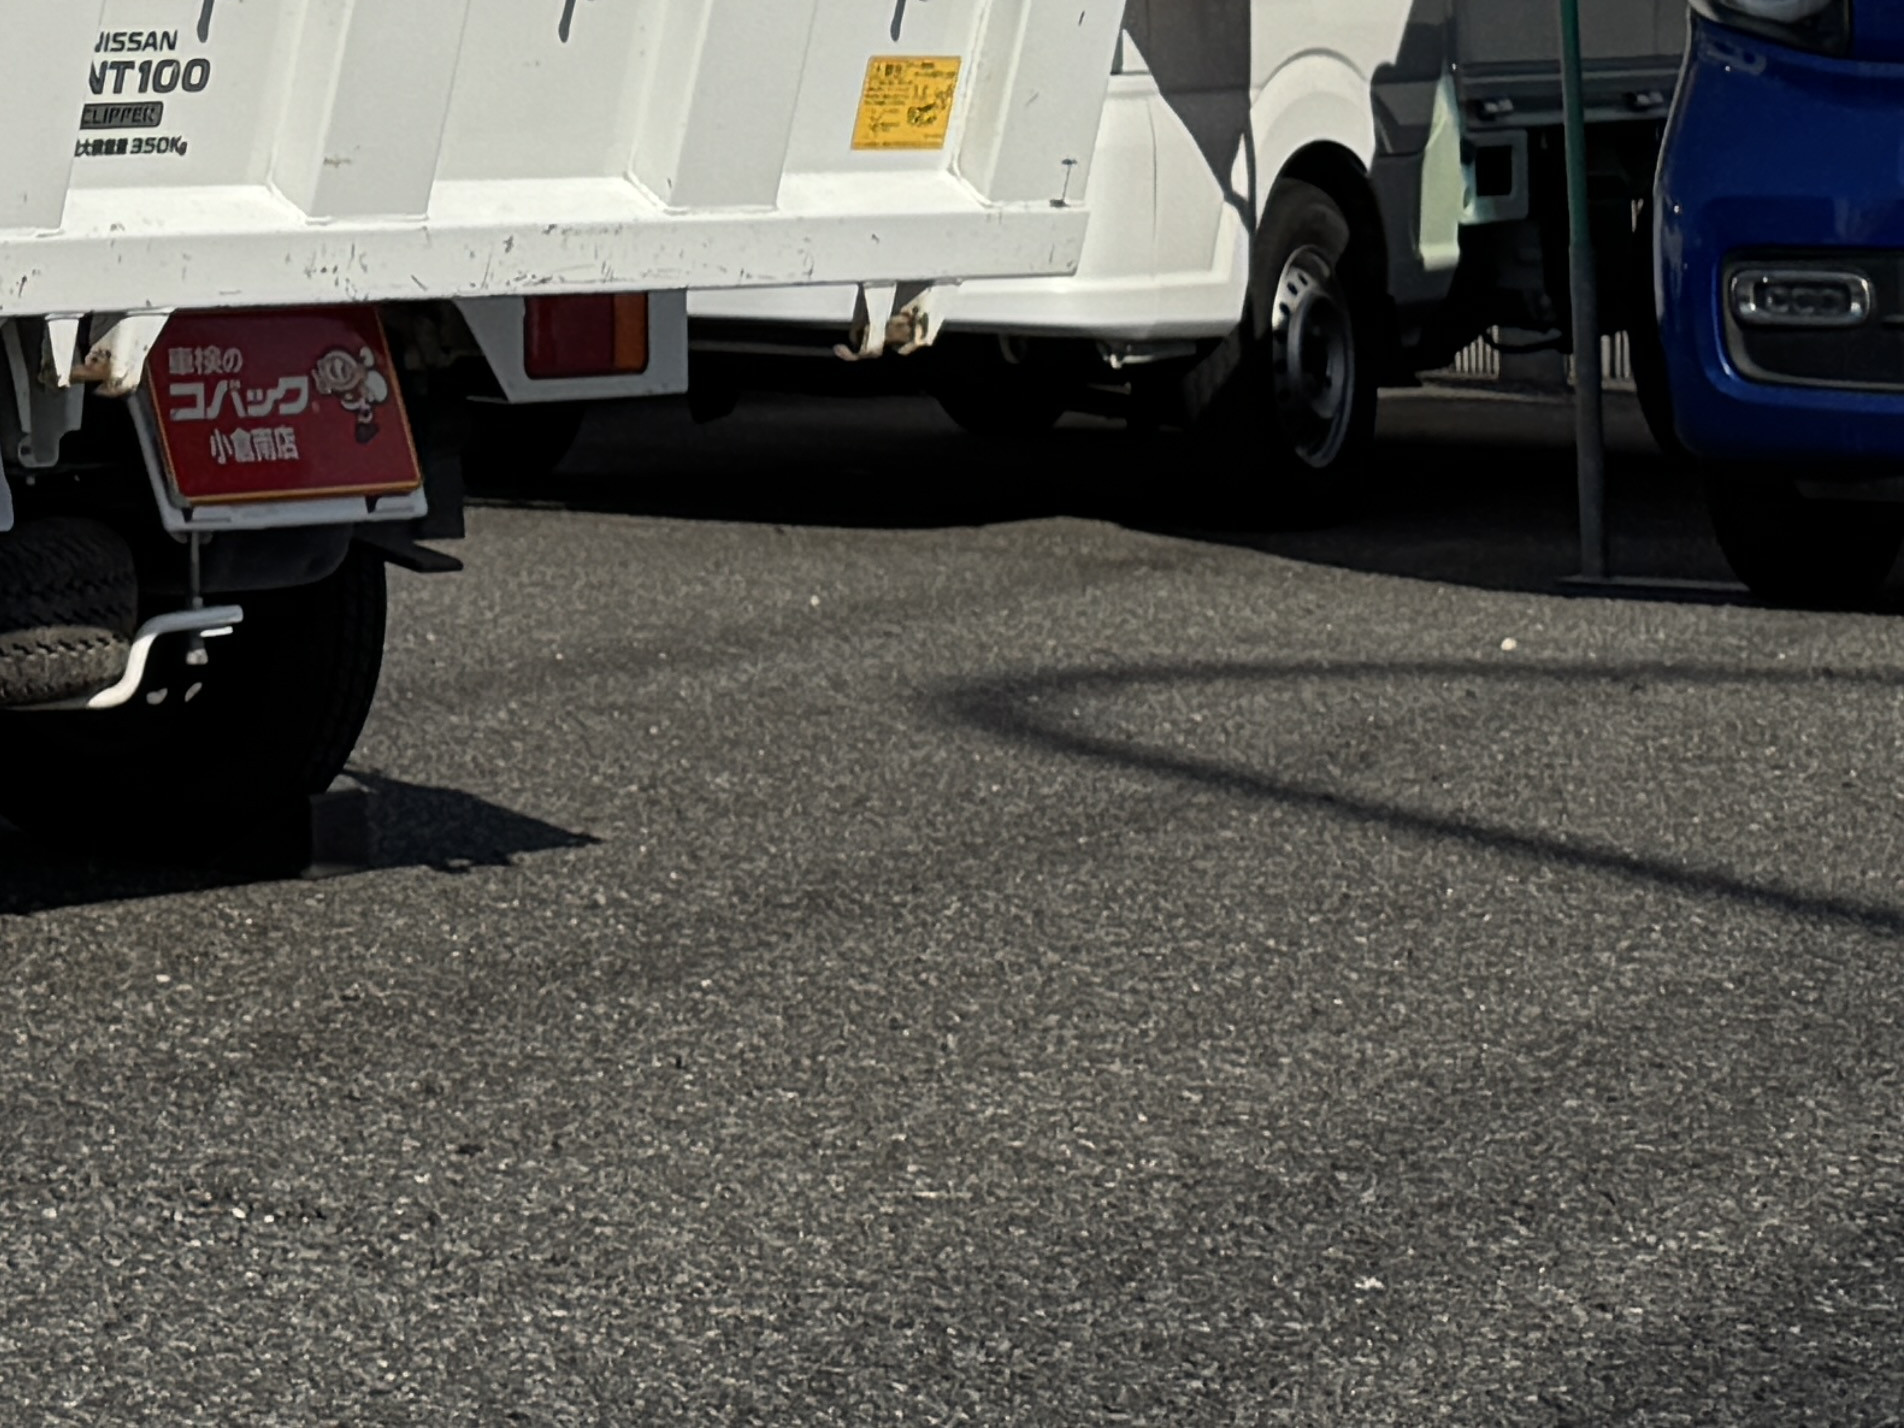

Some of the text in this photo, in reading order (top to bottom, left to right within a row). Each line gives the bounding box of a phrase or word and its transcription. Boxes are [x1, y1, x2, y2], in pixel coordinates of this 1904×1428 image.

[88, 58, 211, 95] NT100
[81, 105, 156, 126] CLIPPER
[167, 344, 243, 376] 車検の
[168, 375, 310, 422] コバック
[209, 426, 300, 465] 小倉南店
